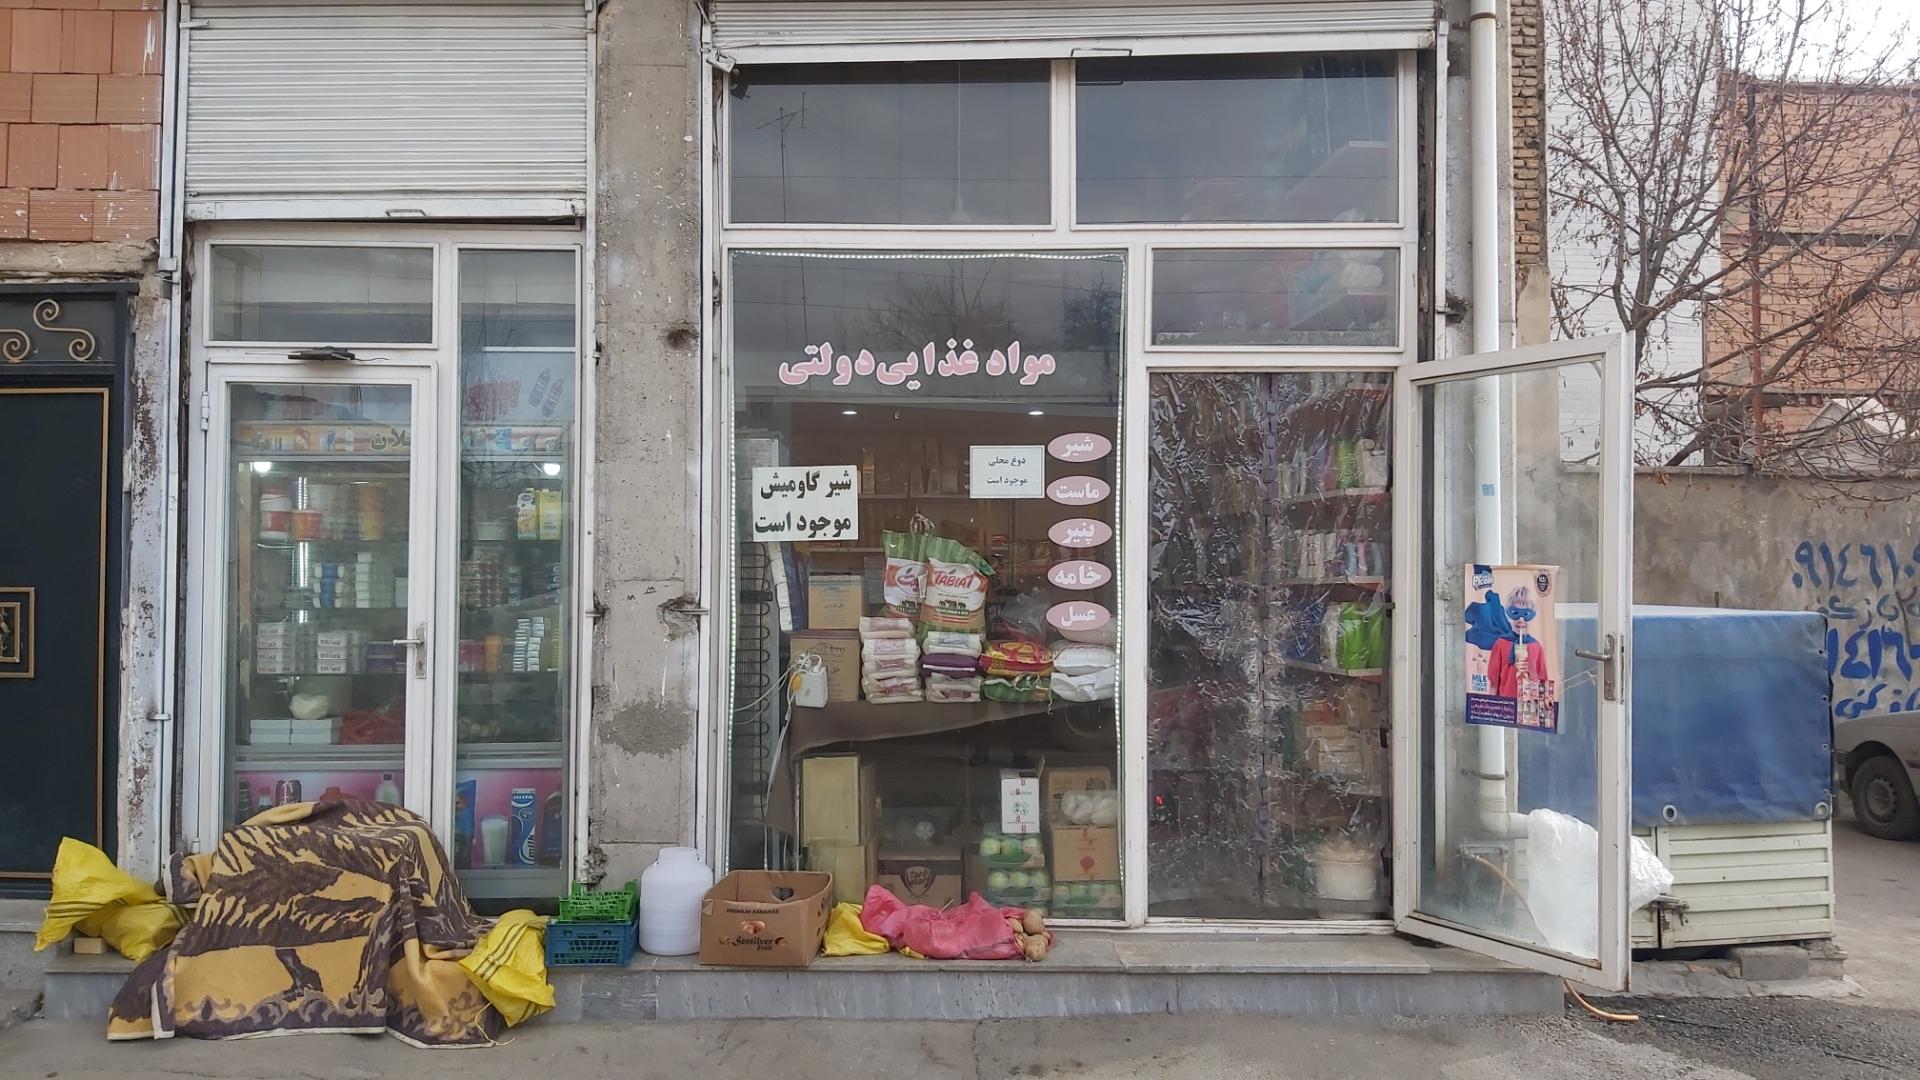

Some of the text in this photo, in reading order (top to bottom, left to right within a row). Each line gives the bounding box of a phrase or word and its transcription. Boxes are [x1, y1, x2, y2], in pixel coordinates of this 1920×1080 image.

[777, 337, 1057, 390] مواد غذایی دولتی
[1061, 438, 1094, 458] شیر
[988, 455, 1026, 467] دوغ محلی
[760, 469, 852, 500] شیر گاومیش
[986, 475, 1028, 487] موجود است
[1055, 481, 1100, 500] ماست
[754, 511, 852, 539] موجود است
[1060, 521, 1095, 545] پنیر
[933, 570, 976, 589] TABIAT
[1053, 565, 1103, 586] خامه
[1060, 605, 1097, 628] عسل
